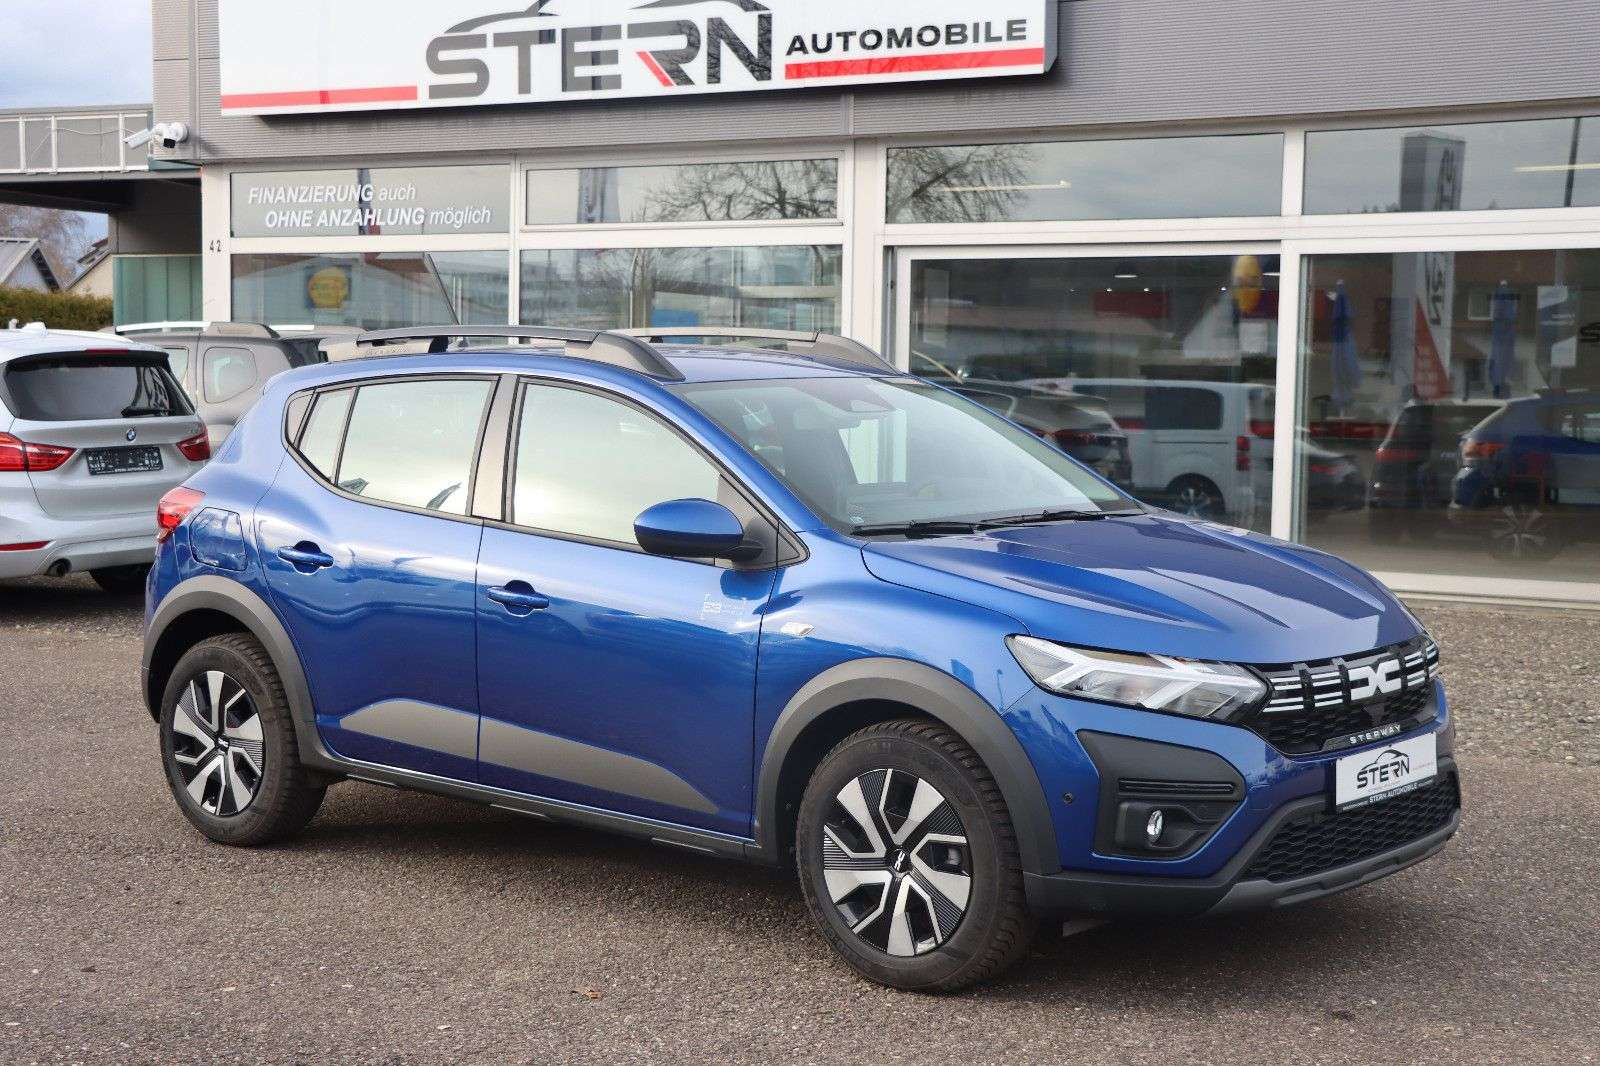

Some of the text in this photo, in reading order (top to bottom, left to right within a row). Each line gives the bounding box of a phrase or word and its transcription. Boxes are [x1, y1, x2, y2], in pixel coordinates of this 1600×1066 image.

[426, 13, 1028, 99] STERN AUTOMOBILE
[248, 183, 417, 204] FINANZIERUNG auch
[265, 205, 491, 229] OHNE ANZAHLUNG möglich
[209, 239, 222, 253] 42
[1356, 757, 1410, 790] STERN
